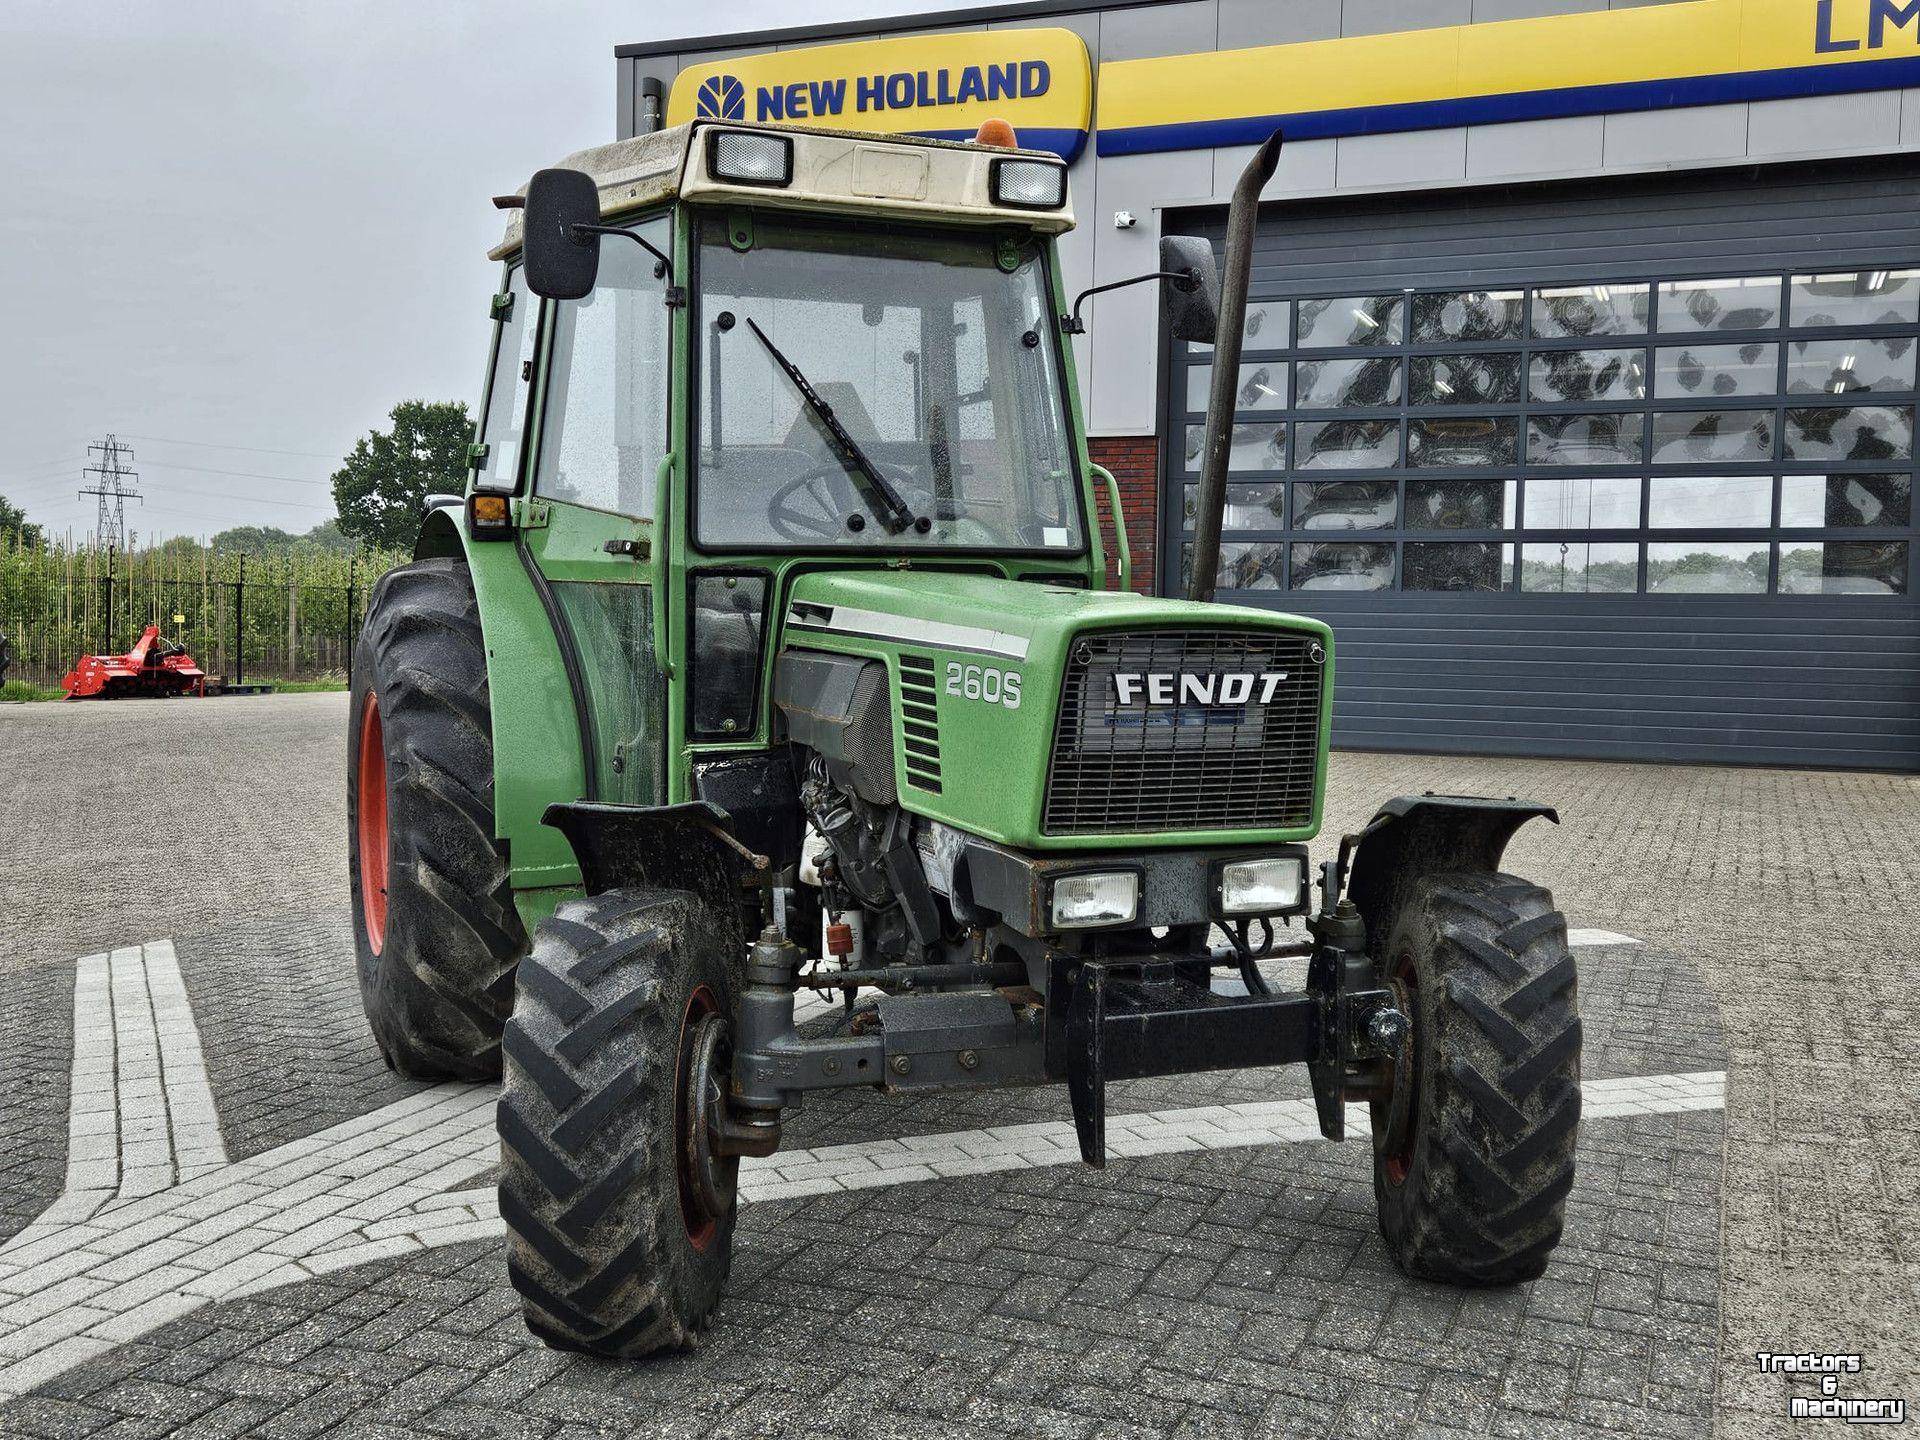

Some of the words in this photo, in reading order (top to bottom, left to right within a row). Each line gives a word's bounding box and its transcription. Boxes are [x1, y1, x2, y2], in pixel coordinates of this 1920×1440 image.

[757, 79, 847, 122] NEW
[856, 60, 1051, 113] HOLLAND
[946, 661, 1022, 710] 260S
[1114, 673, 1289, 705] FENDT
